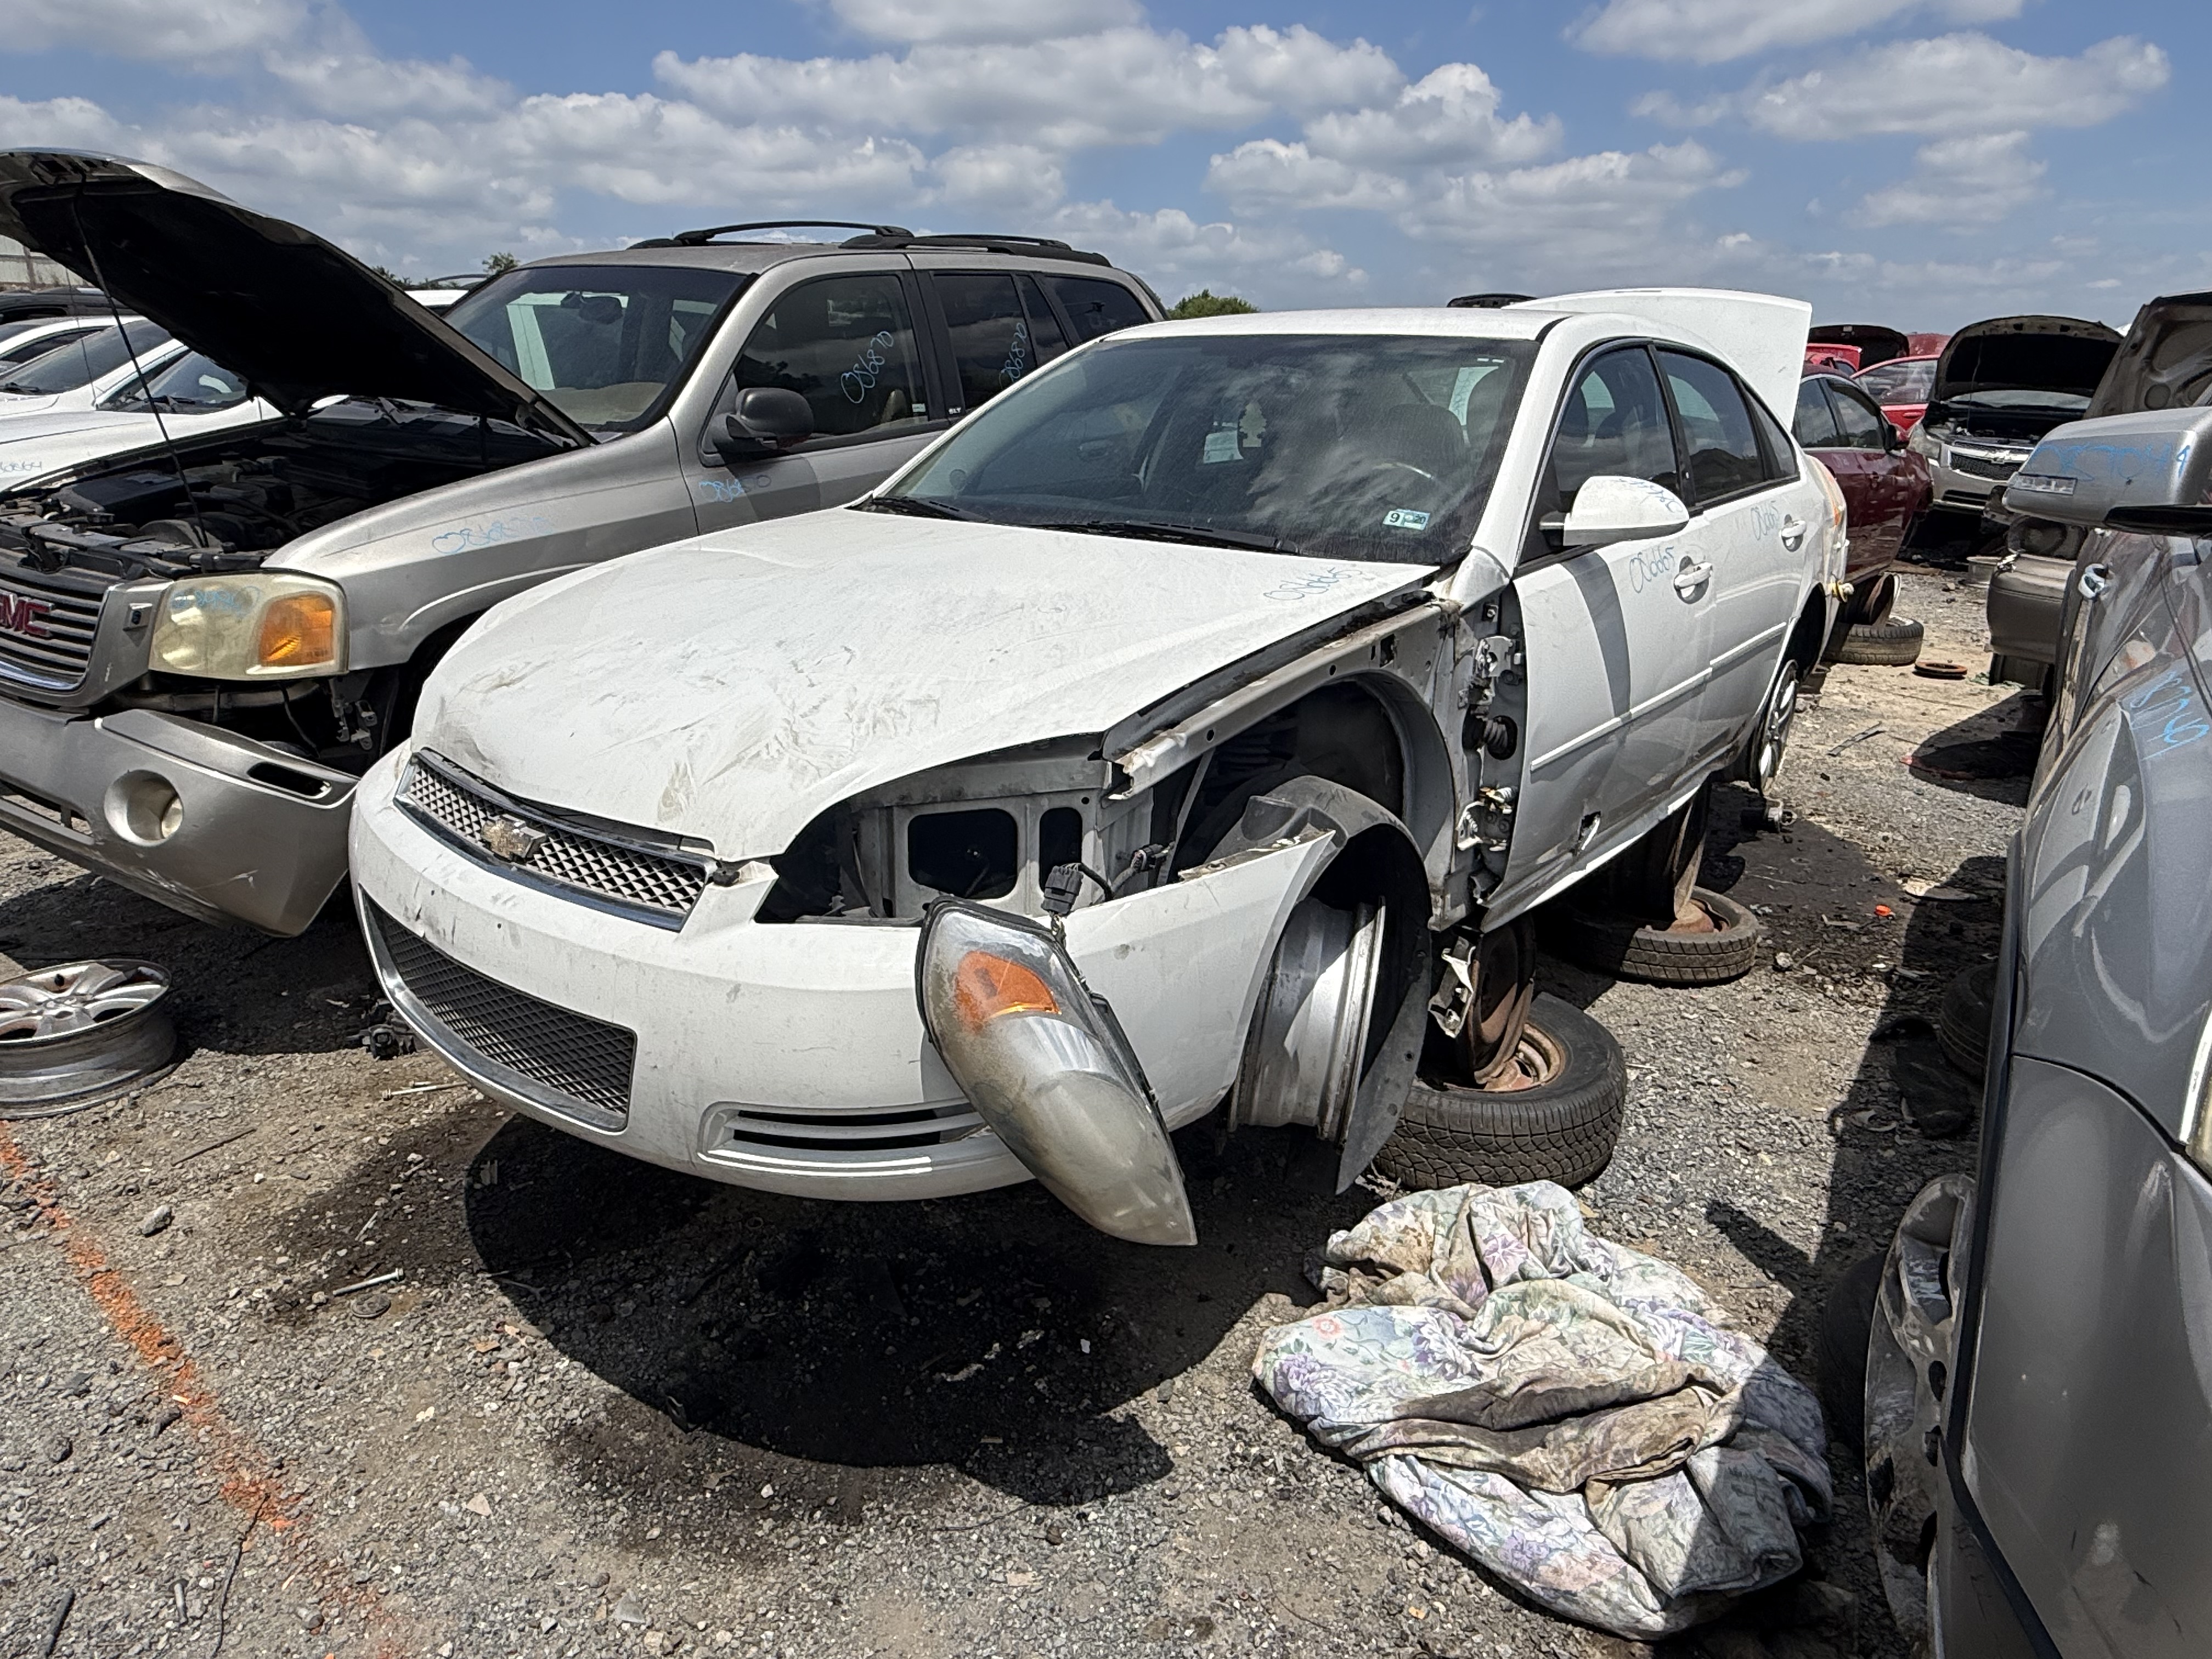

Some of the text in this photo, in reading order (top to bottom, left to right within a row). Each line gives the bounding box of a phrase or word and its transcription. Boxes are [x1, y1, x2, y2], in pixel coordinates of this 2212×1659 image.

[841, 331, 894, 404] 086870
[1389, 512, 1400, 523] 9
[0, 593, 55, 637] MC
